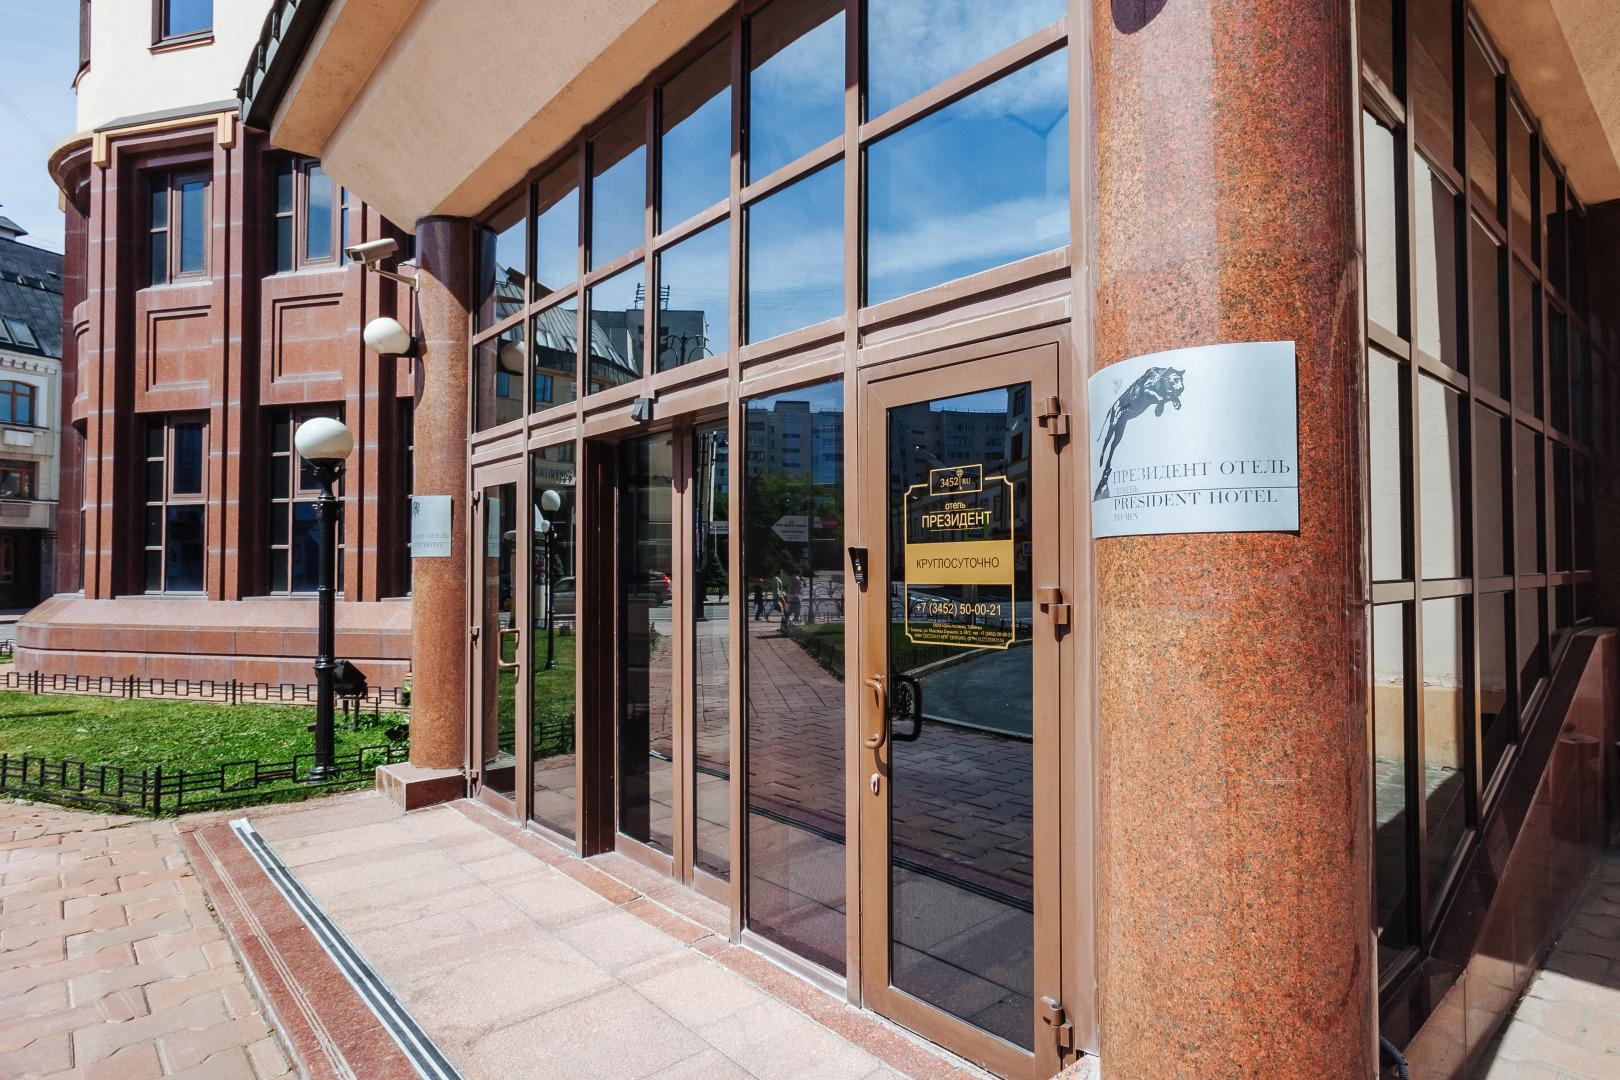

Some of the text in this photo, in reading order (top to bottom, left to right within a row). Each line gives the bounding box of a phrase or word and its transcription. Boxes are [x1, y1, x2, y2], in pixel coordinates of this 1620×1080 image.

[1113, 459, 1291, 484] ПРЕЗИДЕНТ ОТЕЛЬ
[940, 477, 958, 488] 3452
[1113, 486, 1139, 495] ТЮМЕНЬ
[1114, 489, 1278, 510] PRESIDENT HOTEL
[944, 502, 967, 510] отель
[921, 511, 992, 529] ПРЕЗИДЕНТ
[1113, 513, 1139, 522] TYUMEN
[916, 557, 1000, 569] КРУГЛОСУТОЧНО
[916, 602, 1001, 617] +7 (3452) 50-00-21
